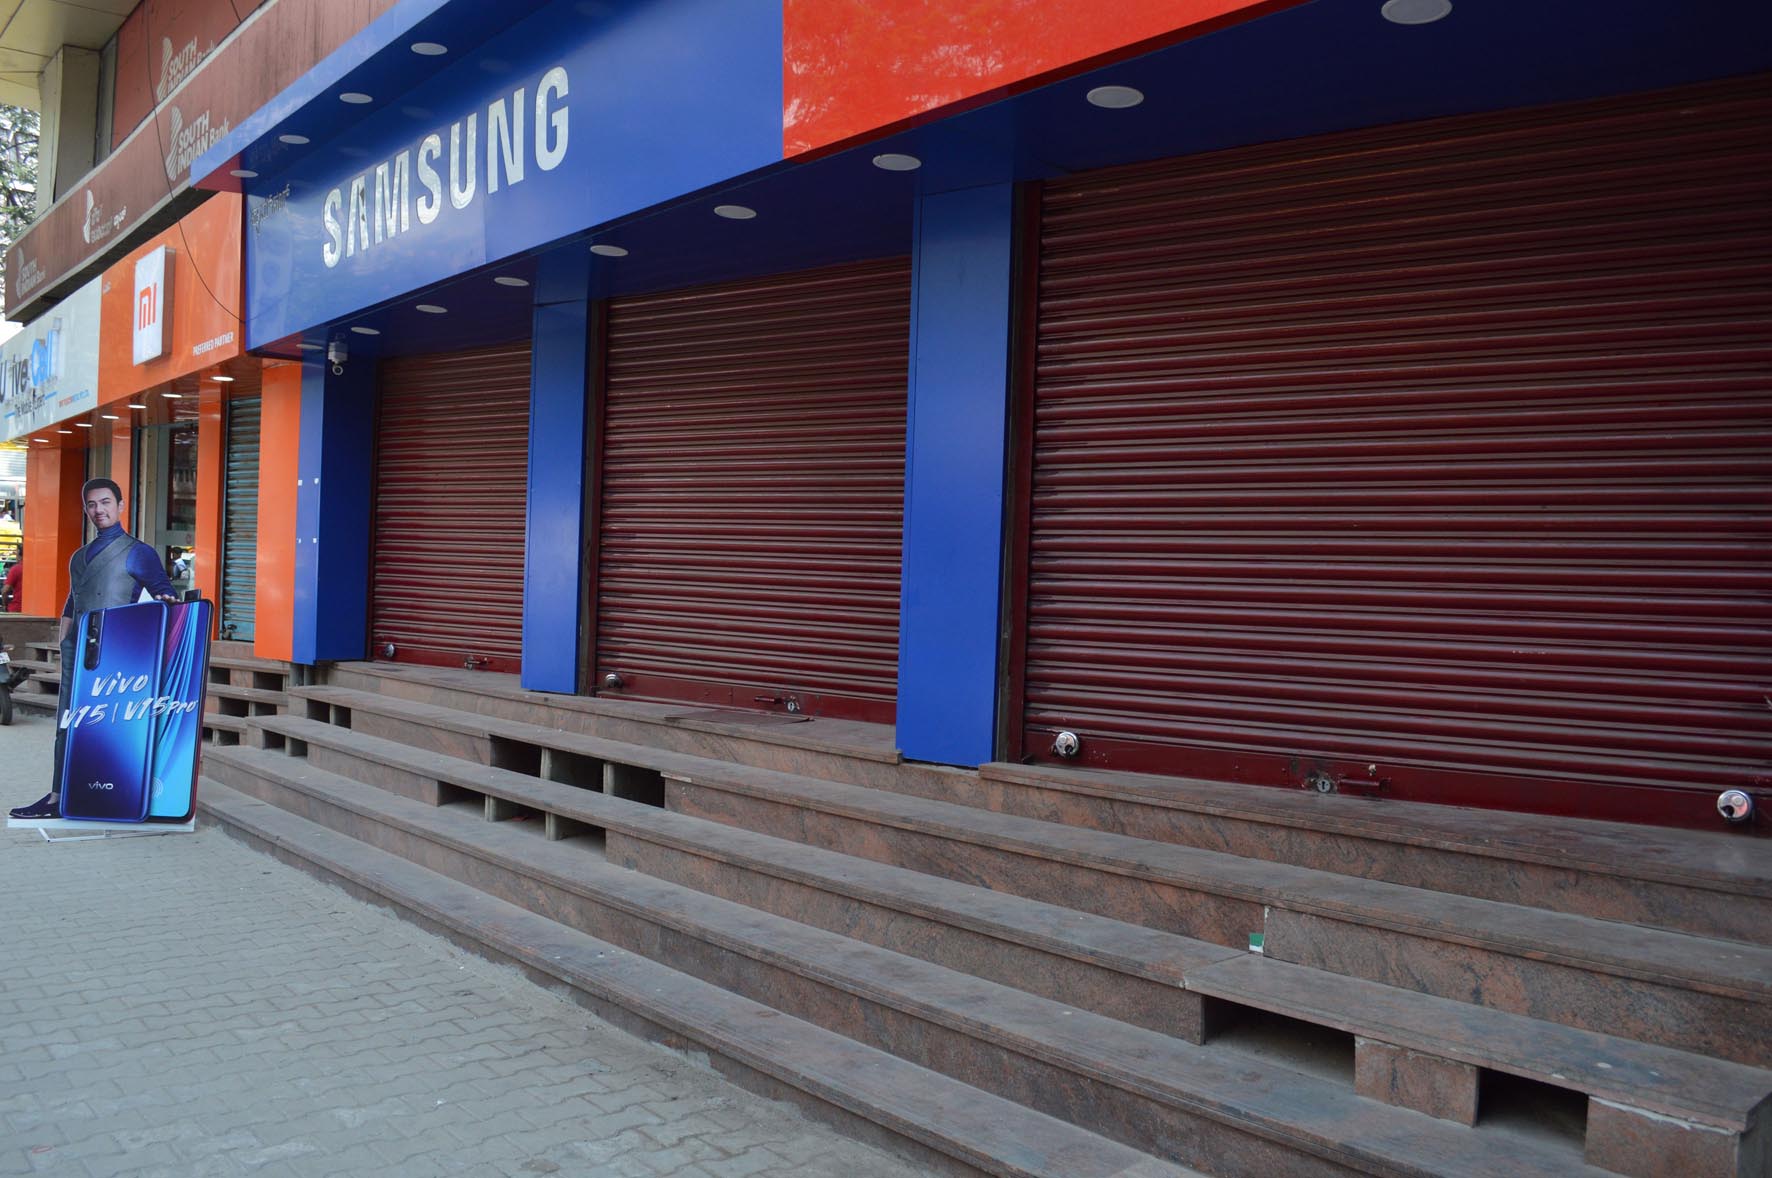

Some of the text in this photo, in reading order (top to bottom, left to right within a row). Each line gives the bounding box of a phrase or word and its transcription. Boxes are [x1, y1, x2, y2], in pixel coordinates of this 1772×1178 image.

[168, 35, 198, 81] SOUTH
[177, 132, 209, 175] INDIAN
[179, 109, 210, 154] SOUTH
[323, 66, 569, 269] SAMSUNG
[60, 703, 109, 729] V15
[88, 780, 114, 790] vivo
